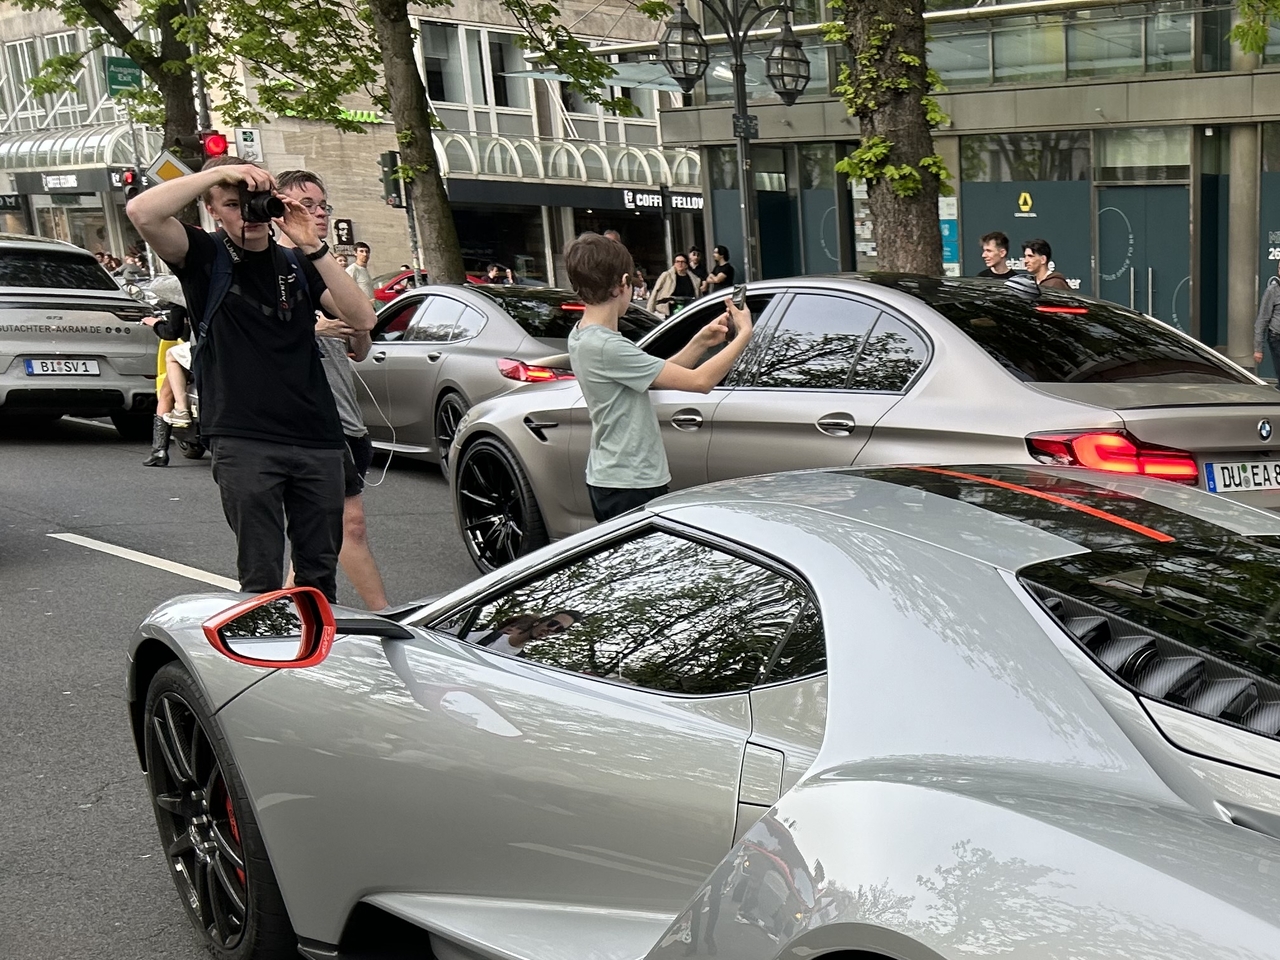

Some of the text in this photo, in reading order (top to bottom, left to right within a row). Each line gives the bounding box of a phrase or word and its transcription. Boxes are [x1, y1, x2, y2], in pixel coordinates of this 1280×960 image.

[109, 64, 141, 76] Ausgang
[117, 73, 132, 82] Exit
[636, 193, 662, 207] COFF
[223, 237, 241, 263] LUMIX
[41, 362, 90, 372] BI SV 1
[1221, 465, 1242, 488] DU
[1250, 464, 1272, 487] EA
